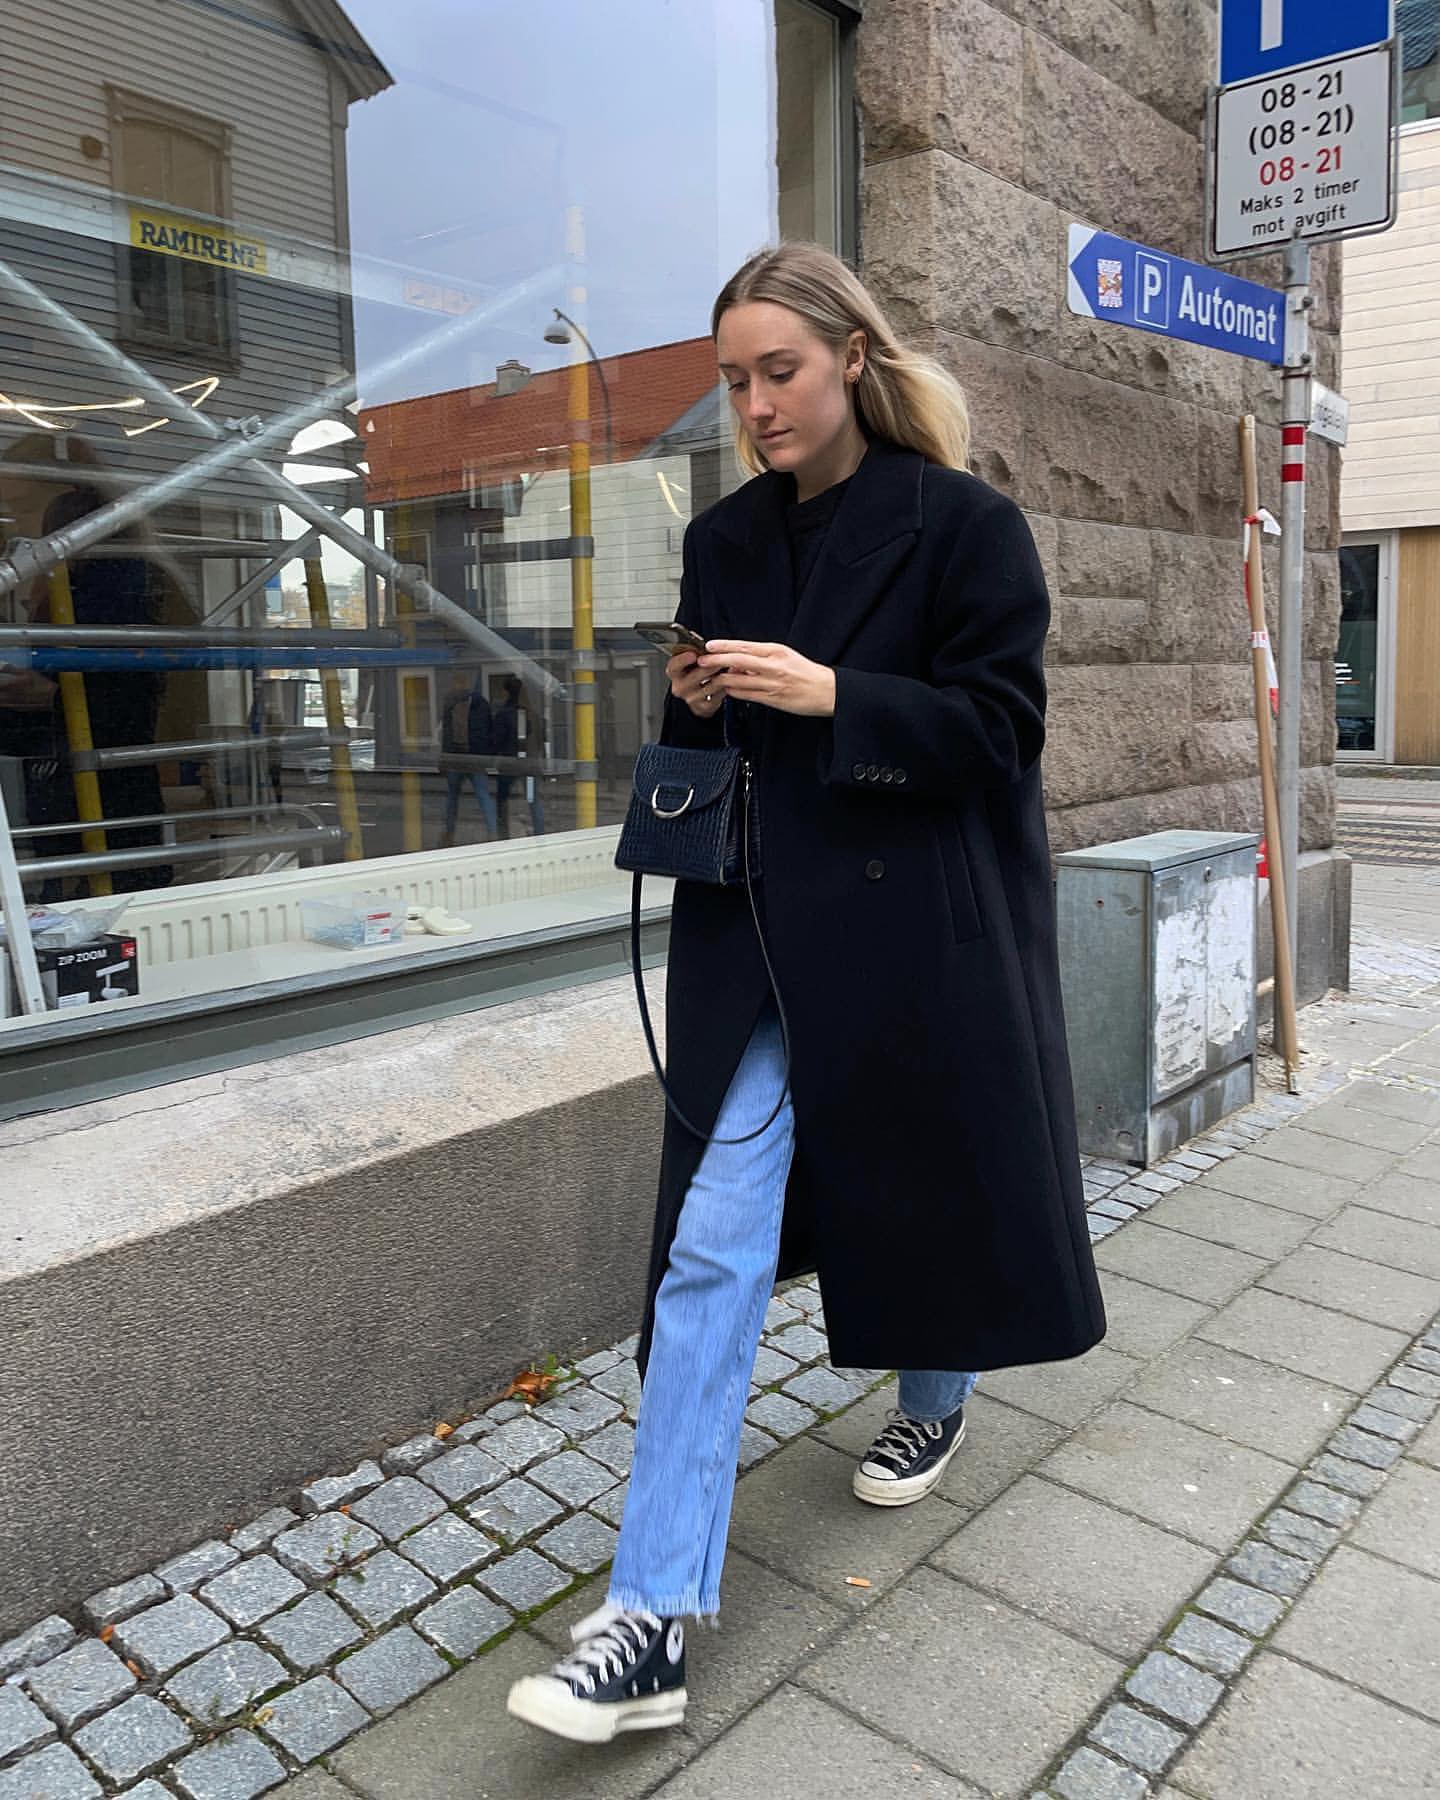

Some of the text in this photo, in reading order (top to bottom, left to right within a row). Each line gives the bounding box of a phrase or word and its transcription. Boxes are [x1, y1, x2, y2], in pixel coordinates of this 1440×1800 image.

[1240, 178, 1360, 215] Maks 2 timer
[1252, 204, 1347, 237] mot avgift
[139, 220, 258, 269] RAMIRENT
[1143, 263, 1277, 345] P Automat
[58, 948, 108, 966] ZIP ZOOM
